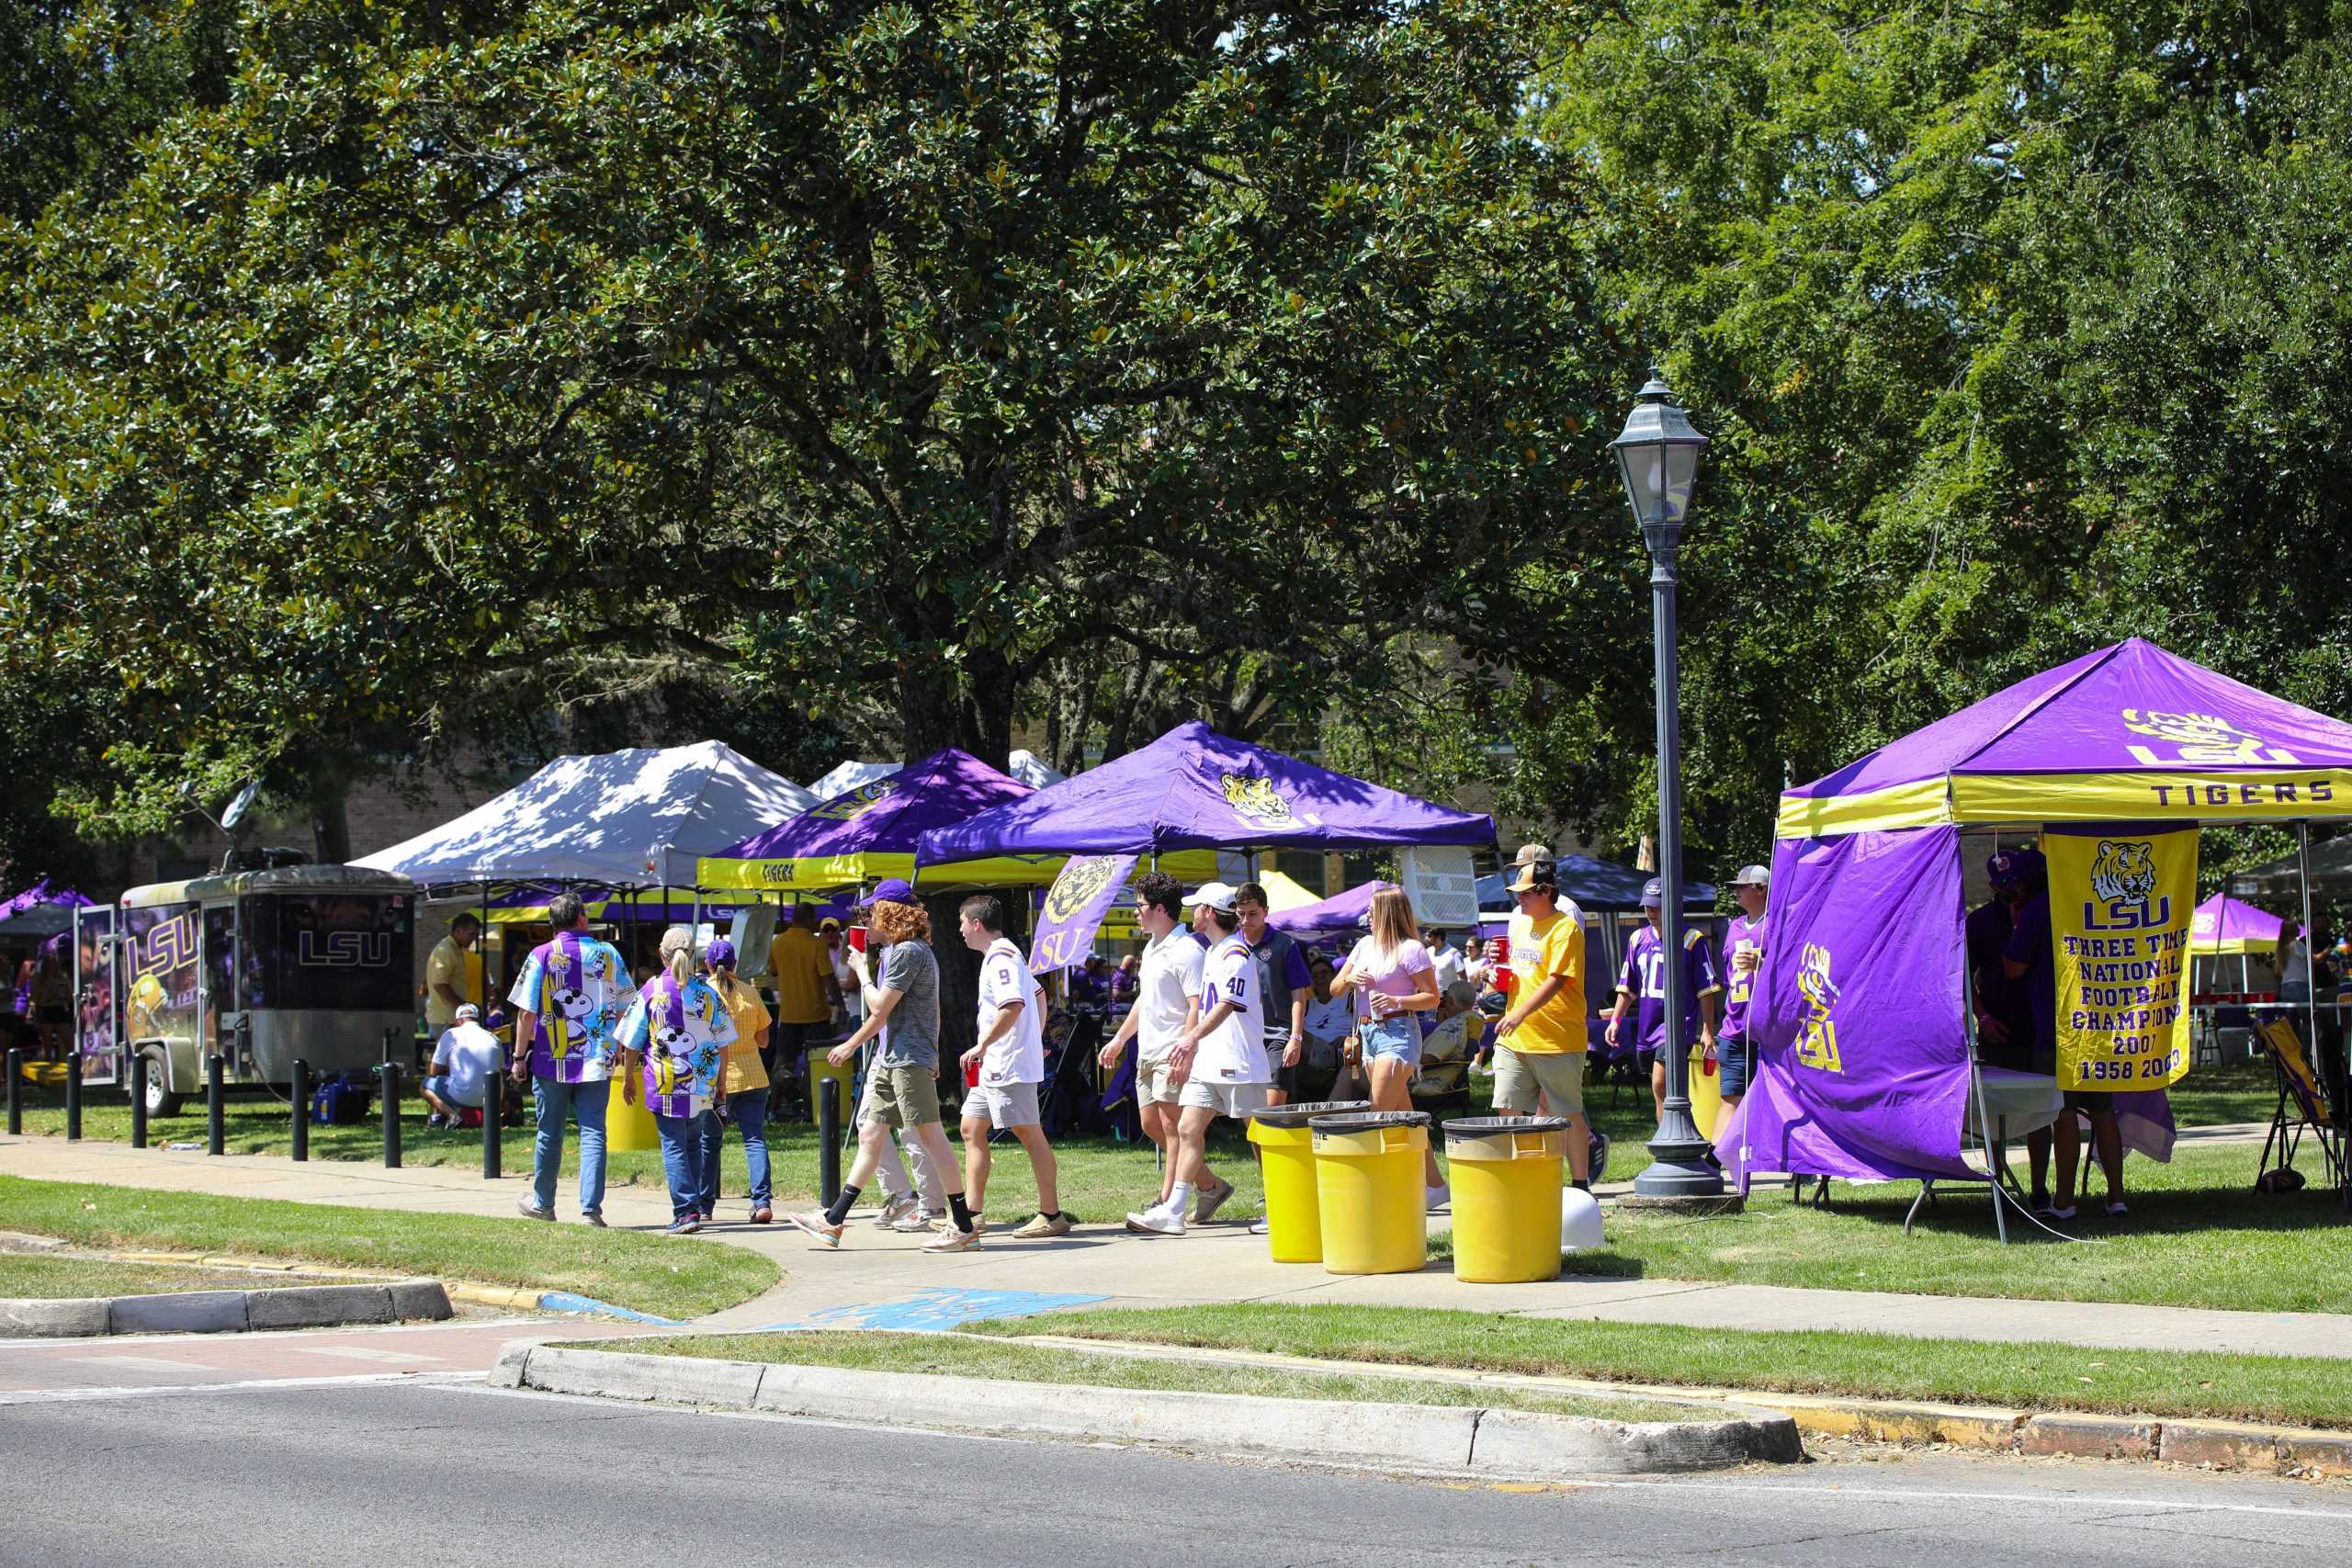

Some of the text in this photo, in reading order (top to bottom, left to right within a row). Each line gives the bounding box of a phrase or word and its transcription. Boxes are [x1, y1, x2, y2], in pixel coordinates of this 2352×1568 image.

[2151, 781, 2334, 806] TIGERS
[763, 863, 795, 883] TIGERS
[2084, 896, 2171, 931] LSU
[125, 908, 200, 989] LSU
[299, 930, 390, 966] LSU
[1029, 927, 1086, 971] LSU
[2064, 927, 2188, 958] THREE TIME
[999, 968, 1011, 986] 9
[2079, 954, 2181, 983] NATIONAL
[1226, 976, 1246, 998] 40
[2080, 980, 2180, 1008] FOOTBALL
[2081, 1049, 2180, 1081] 1958 2003
